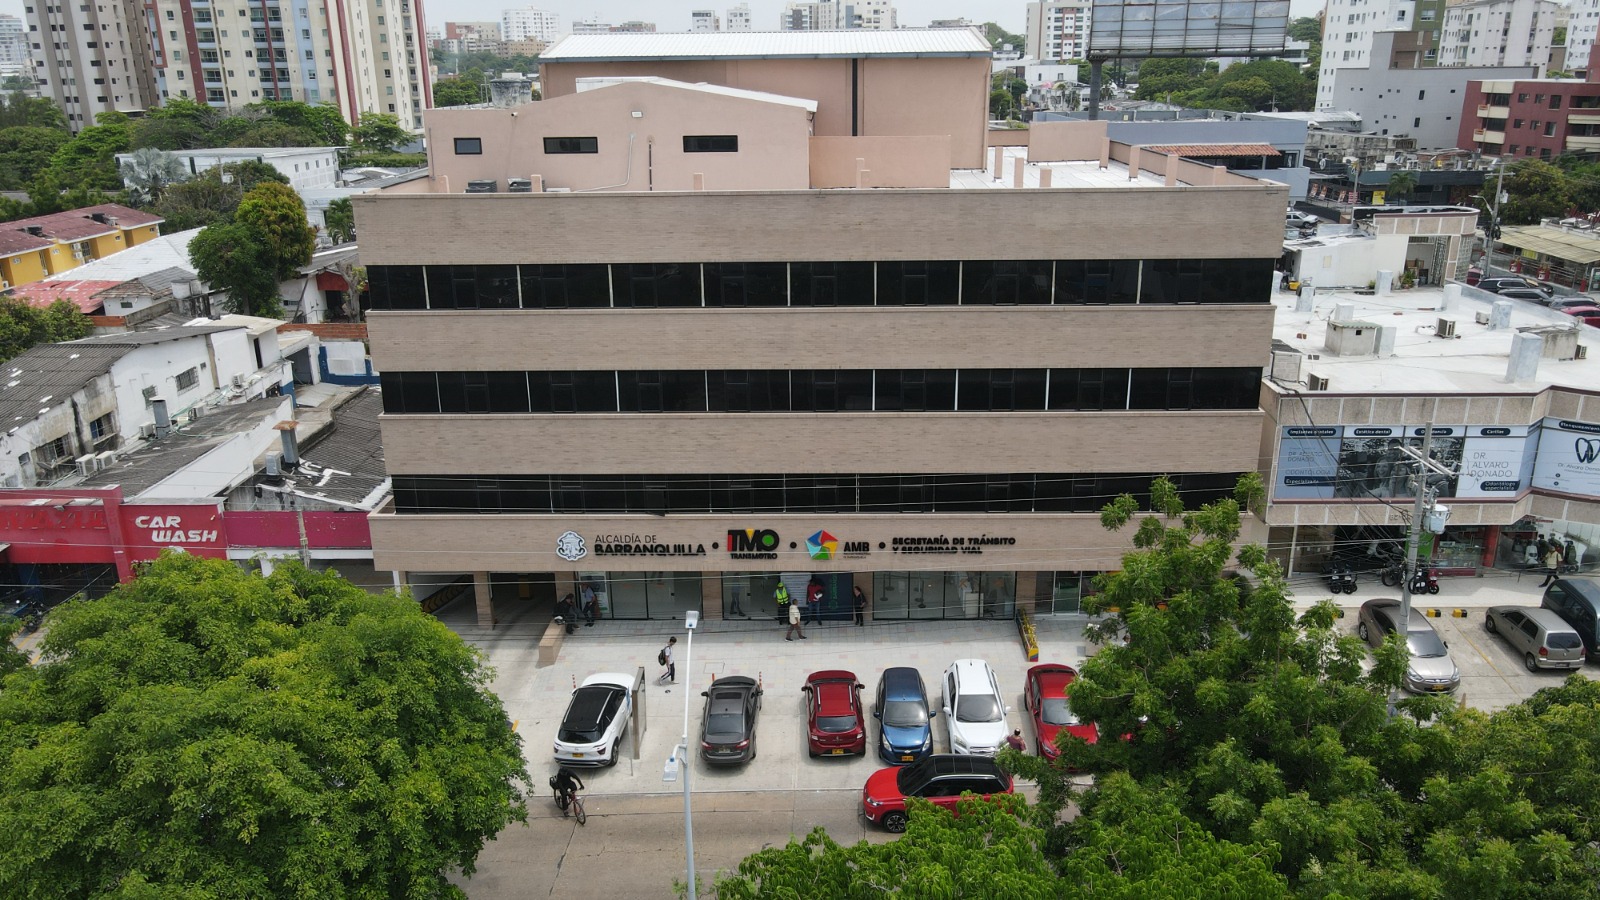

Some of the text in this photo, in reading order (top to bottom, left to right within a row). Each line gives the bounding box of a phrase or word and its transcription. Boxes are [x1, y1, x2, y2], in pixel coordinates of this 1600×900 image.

[1472, 461, 1509, 469] ALVARO
[1470, 469, 1513, 478] DONADO
[135, 515, 181, 528] CAR
[151, 529, 218, 542] WASH
[595, 533, 657, 543] ALCALDÍA DE
[727, 528, 780, 552] TMO
[892, 535, 949, 545] SECRETARÍA
[967, 534, 1016, 545] TRÁNSITO
[594, 544, 707, 556] BARRANQUILLA
[843, 541, 870, 552] AMB
[892, 546, 983, 554] Y SEGURIDAD VIAL
